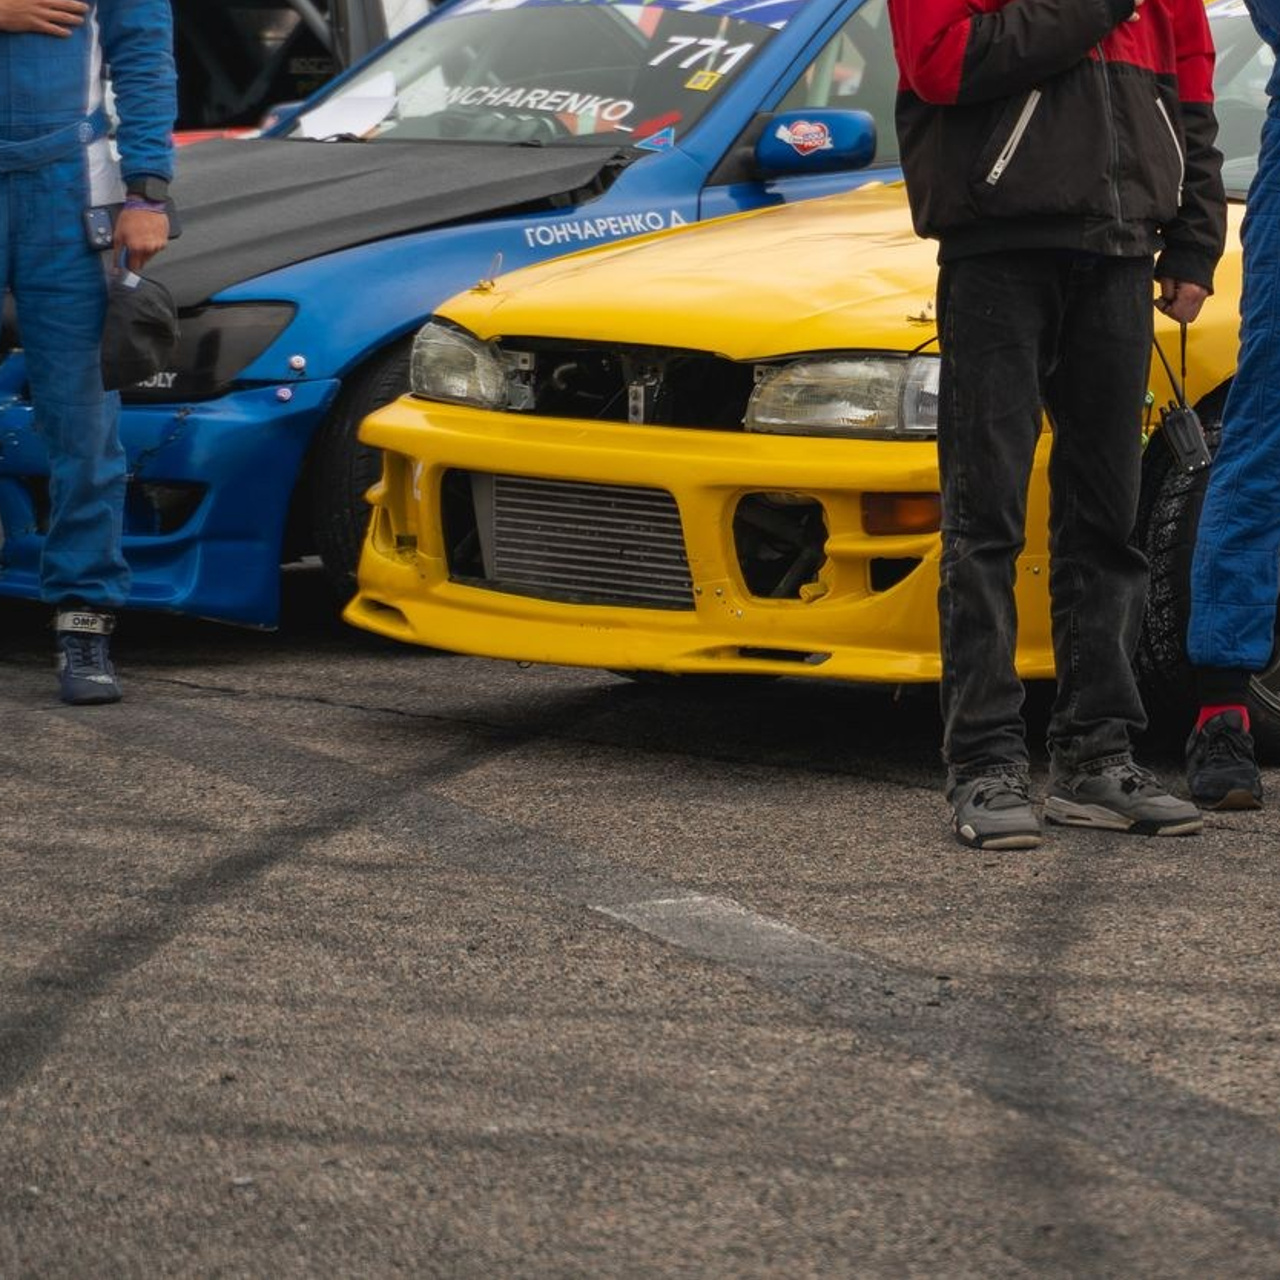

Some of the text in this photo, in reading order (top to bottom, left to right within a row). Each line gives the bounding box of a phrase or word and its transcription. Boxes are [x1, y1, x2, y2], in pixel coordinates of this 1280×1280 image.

[648, 36, 755, 75] 771
[442, 86, 635, 121] NCHARENKO
[524, 211, 664, 248] ГОНЧАРЕНКО
[73, 617, 98, 628] OMP
